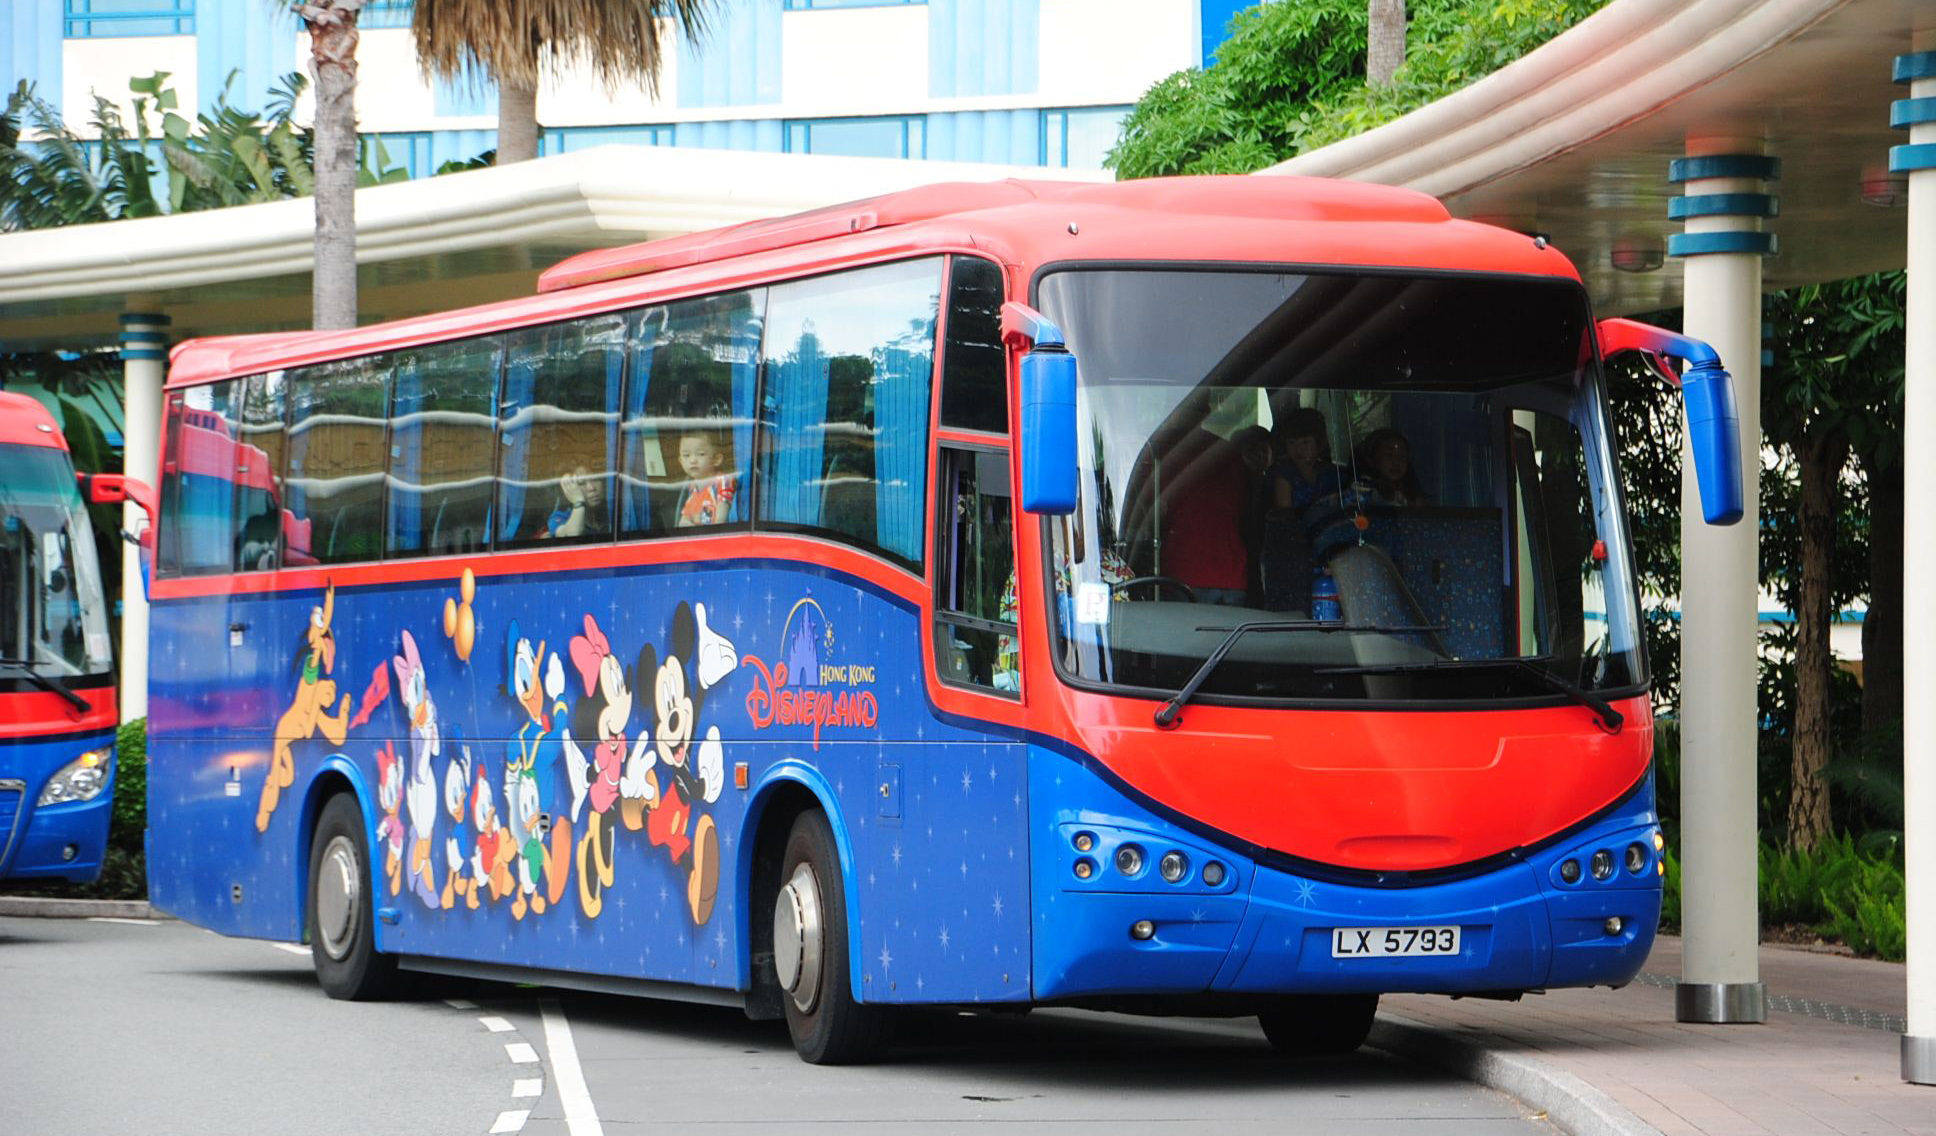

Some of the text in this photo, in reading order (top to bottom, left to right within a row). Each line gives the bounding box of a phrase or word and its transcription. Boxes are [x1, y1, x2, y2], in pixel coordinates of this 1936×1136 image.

[820, 664, 875, 686] HONG KONG
[1337, 929, 1455, 954] LX 5793
